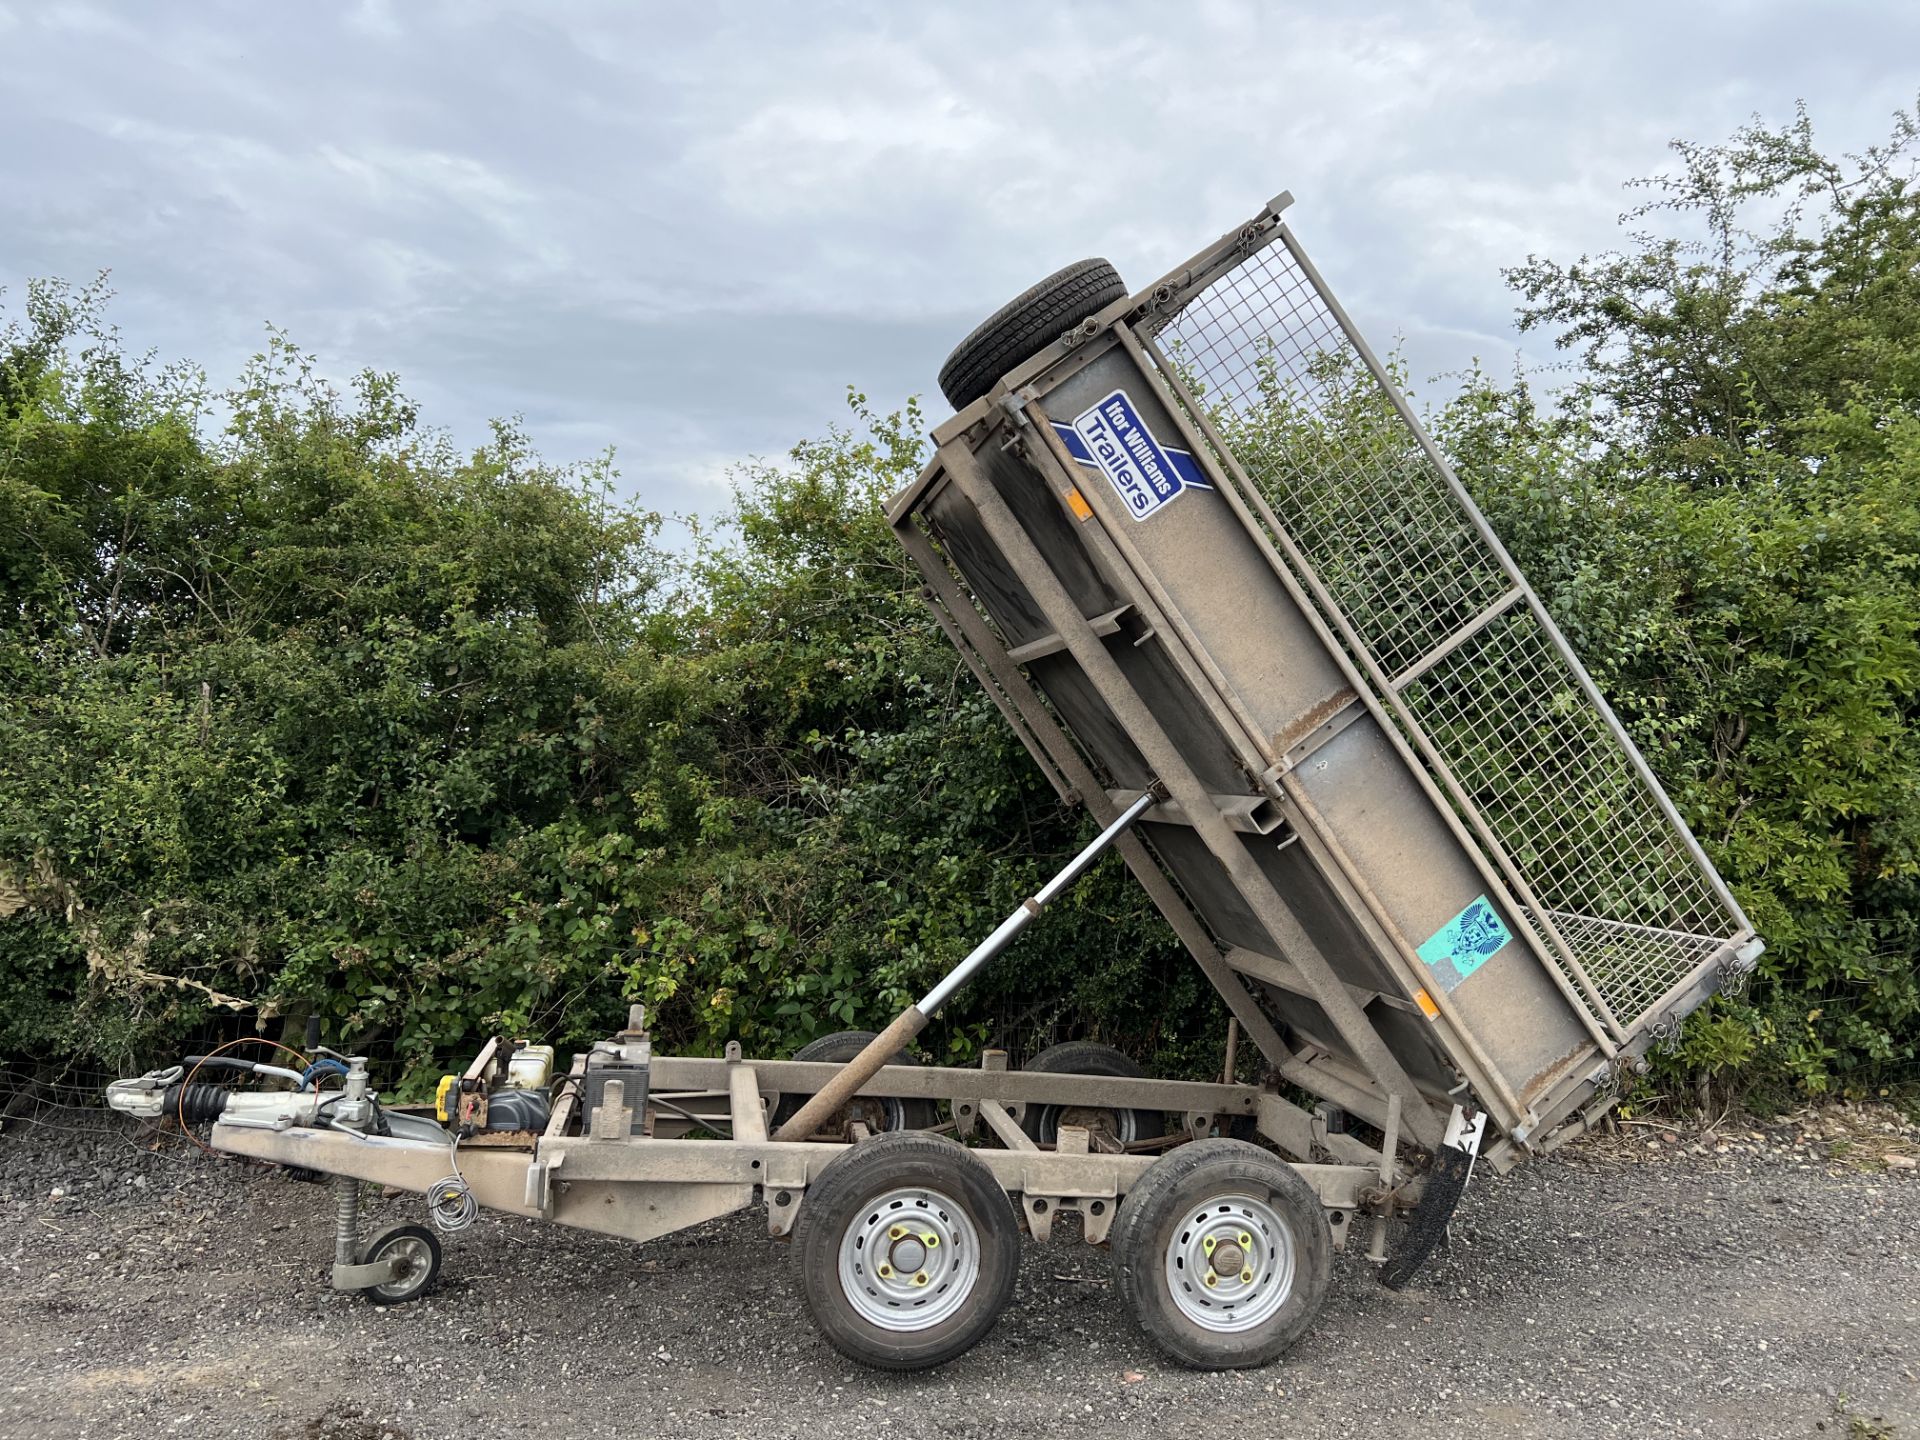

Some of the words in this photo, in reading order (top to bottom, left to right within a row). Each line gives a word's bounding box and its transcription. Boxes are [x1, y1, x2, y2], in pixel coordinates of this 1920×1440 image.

[1086, 416, 1150, 511] Trailers
[1105, 400, 1131, 431] Ifor
[1123, 426, 1172, 495] Williams
